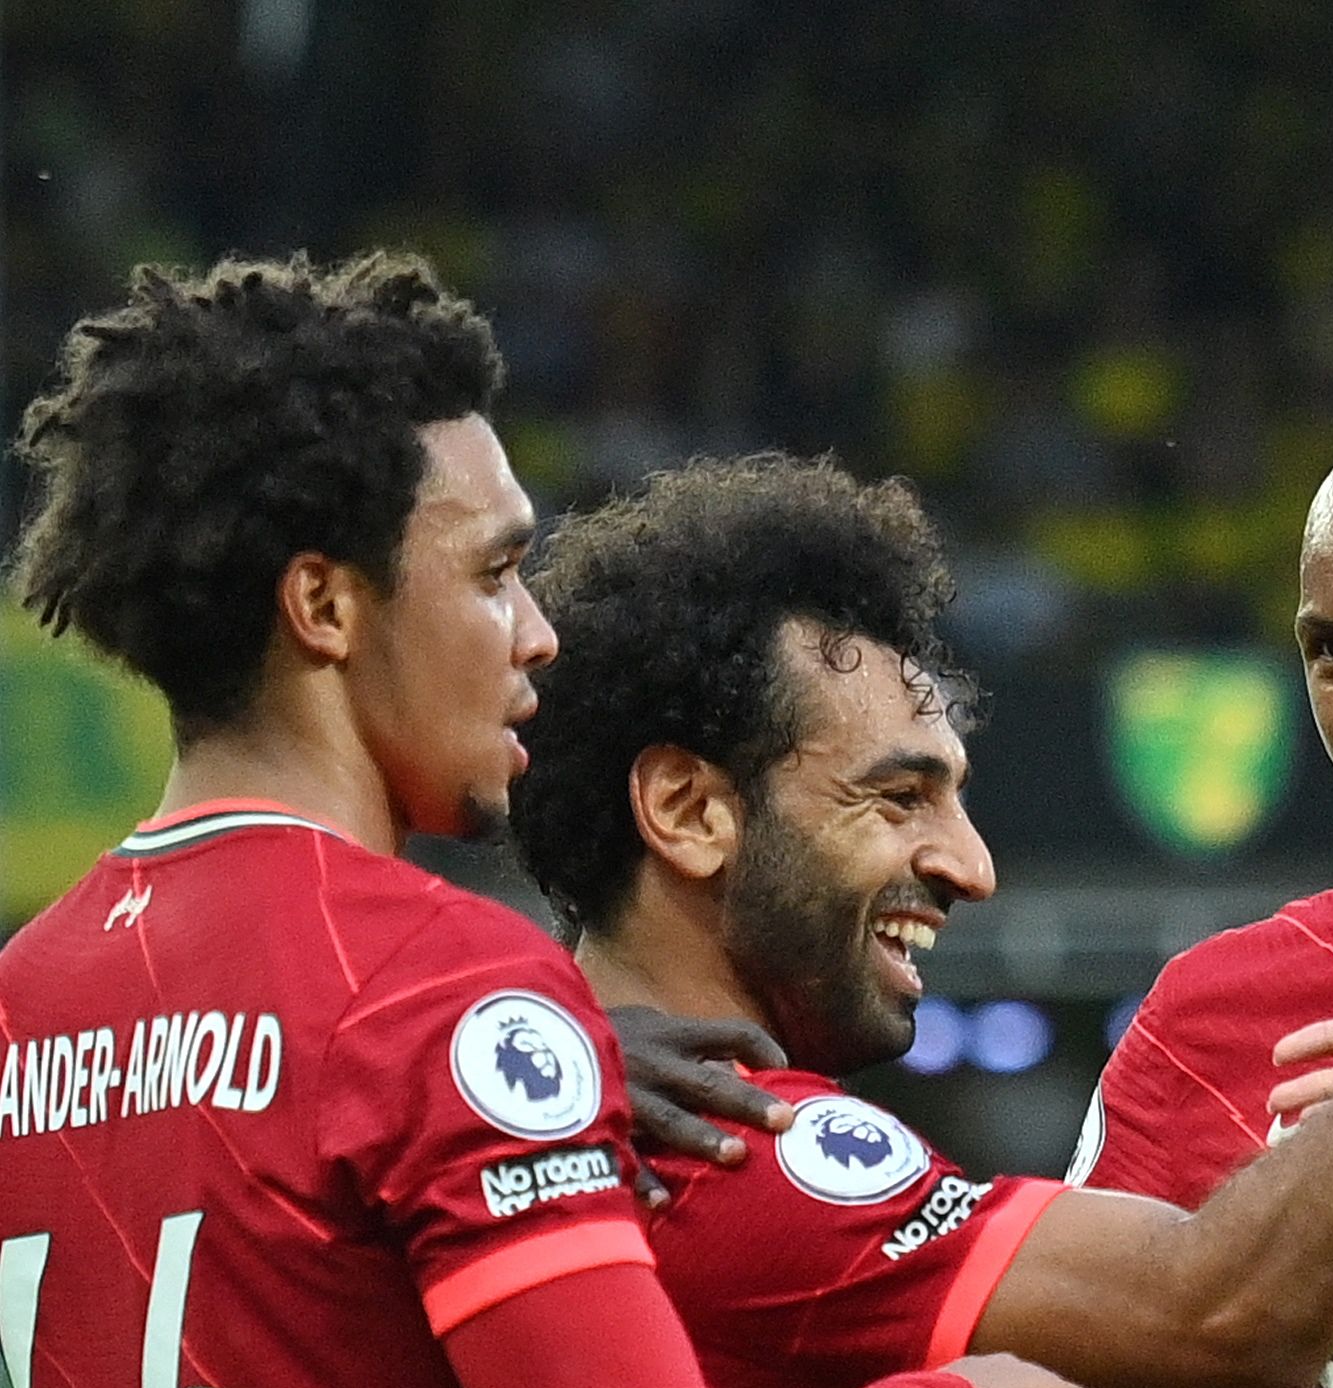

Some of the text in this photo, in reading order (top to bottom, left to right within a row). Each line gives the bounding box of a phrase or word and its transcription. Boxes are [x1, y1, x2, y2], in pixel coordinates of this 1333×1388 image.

[0, 1009, 283, 1138] ANDER-ARNOLD
[480, 1165, 533, 1196] No
[532, 1149, 611, 1187] room
[880, 1221, 929, 1262] No
